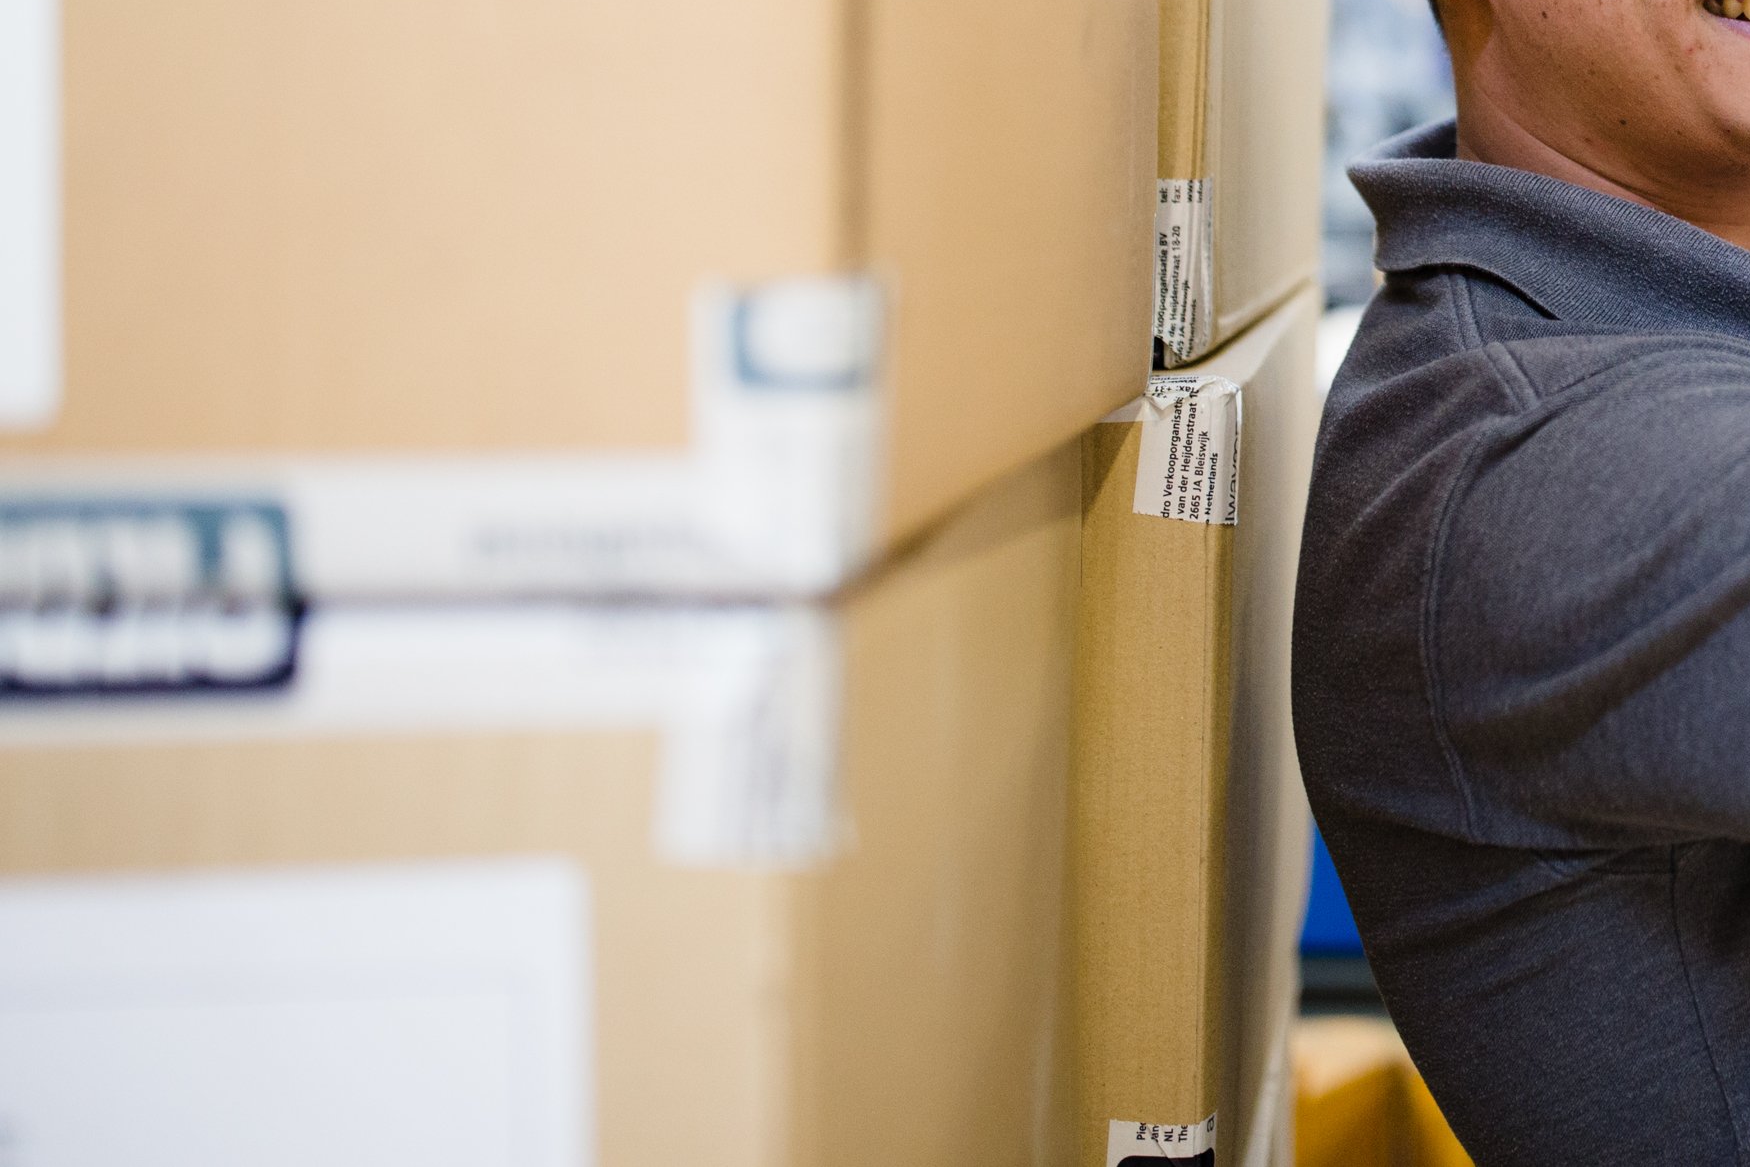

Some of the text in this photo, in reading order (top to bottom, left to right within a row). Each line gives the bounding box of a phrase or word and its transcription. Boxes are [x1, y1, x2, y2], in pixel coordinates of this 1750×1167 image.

[1159, 232, 1168, 246] BV
[1171, 225, 1181, 250] 18-20
[1181, 402, 1199, 472] Heijdenstraat
[1178, 474, 1189, 493] der
[1189, 430, 1210, 520] 2665 JA Bleiswijk
[1204, 452, 1219, 515] Netherlands
[1177, 495, 1187, 515] van
[1151, 1125, 1159, 1142] Jan
[1164, 1128, 1173, 1142] NL
